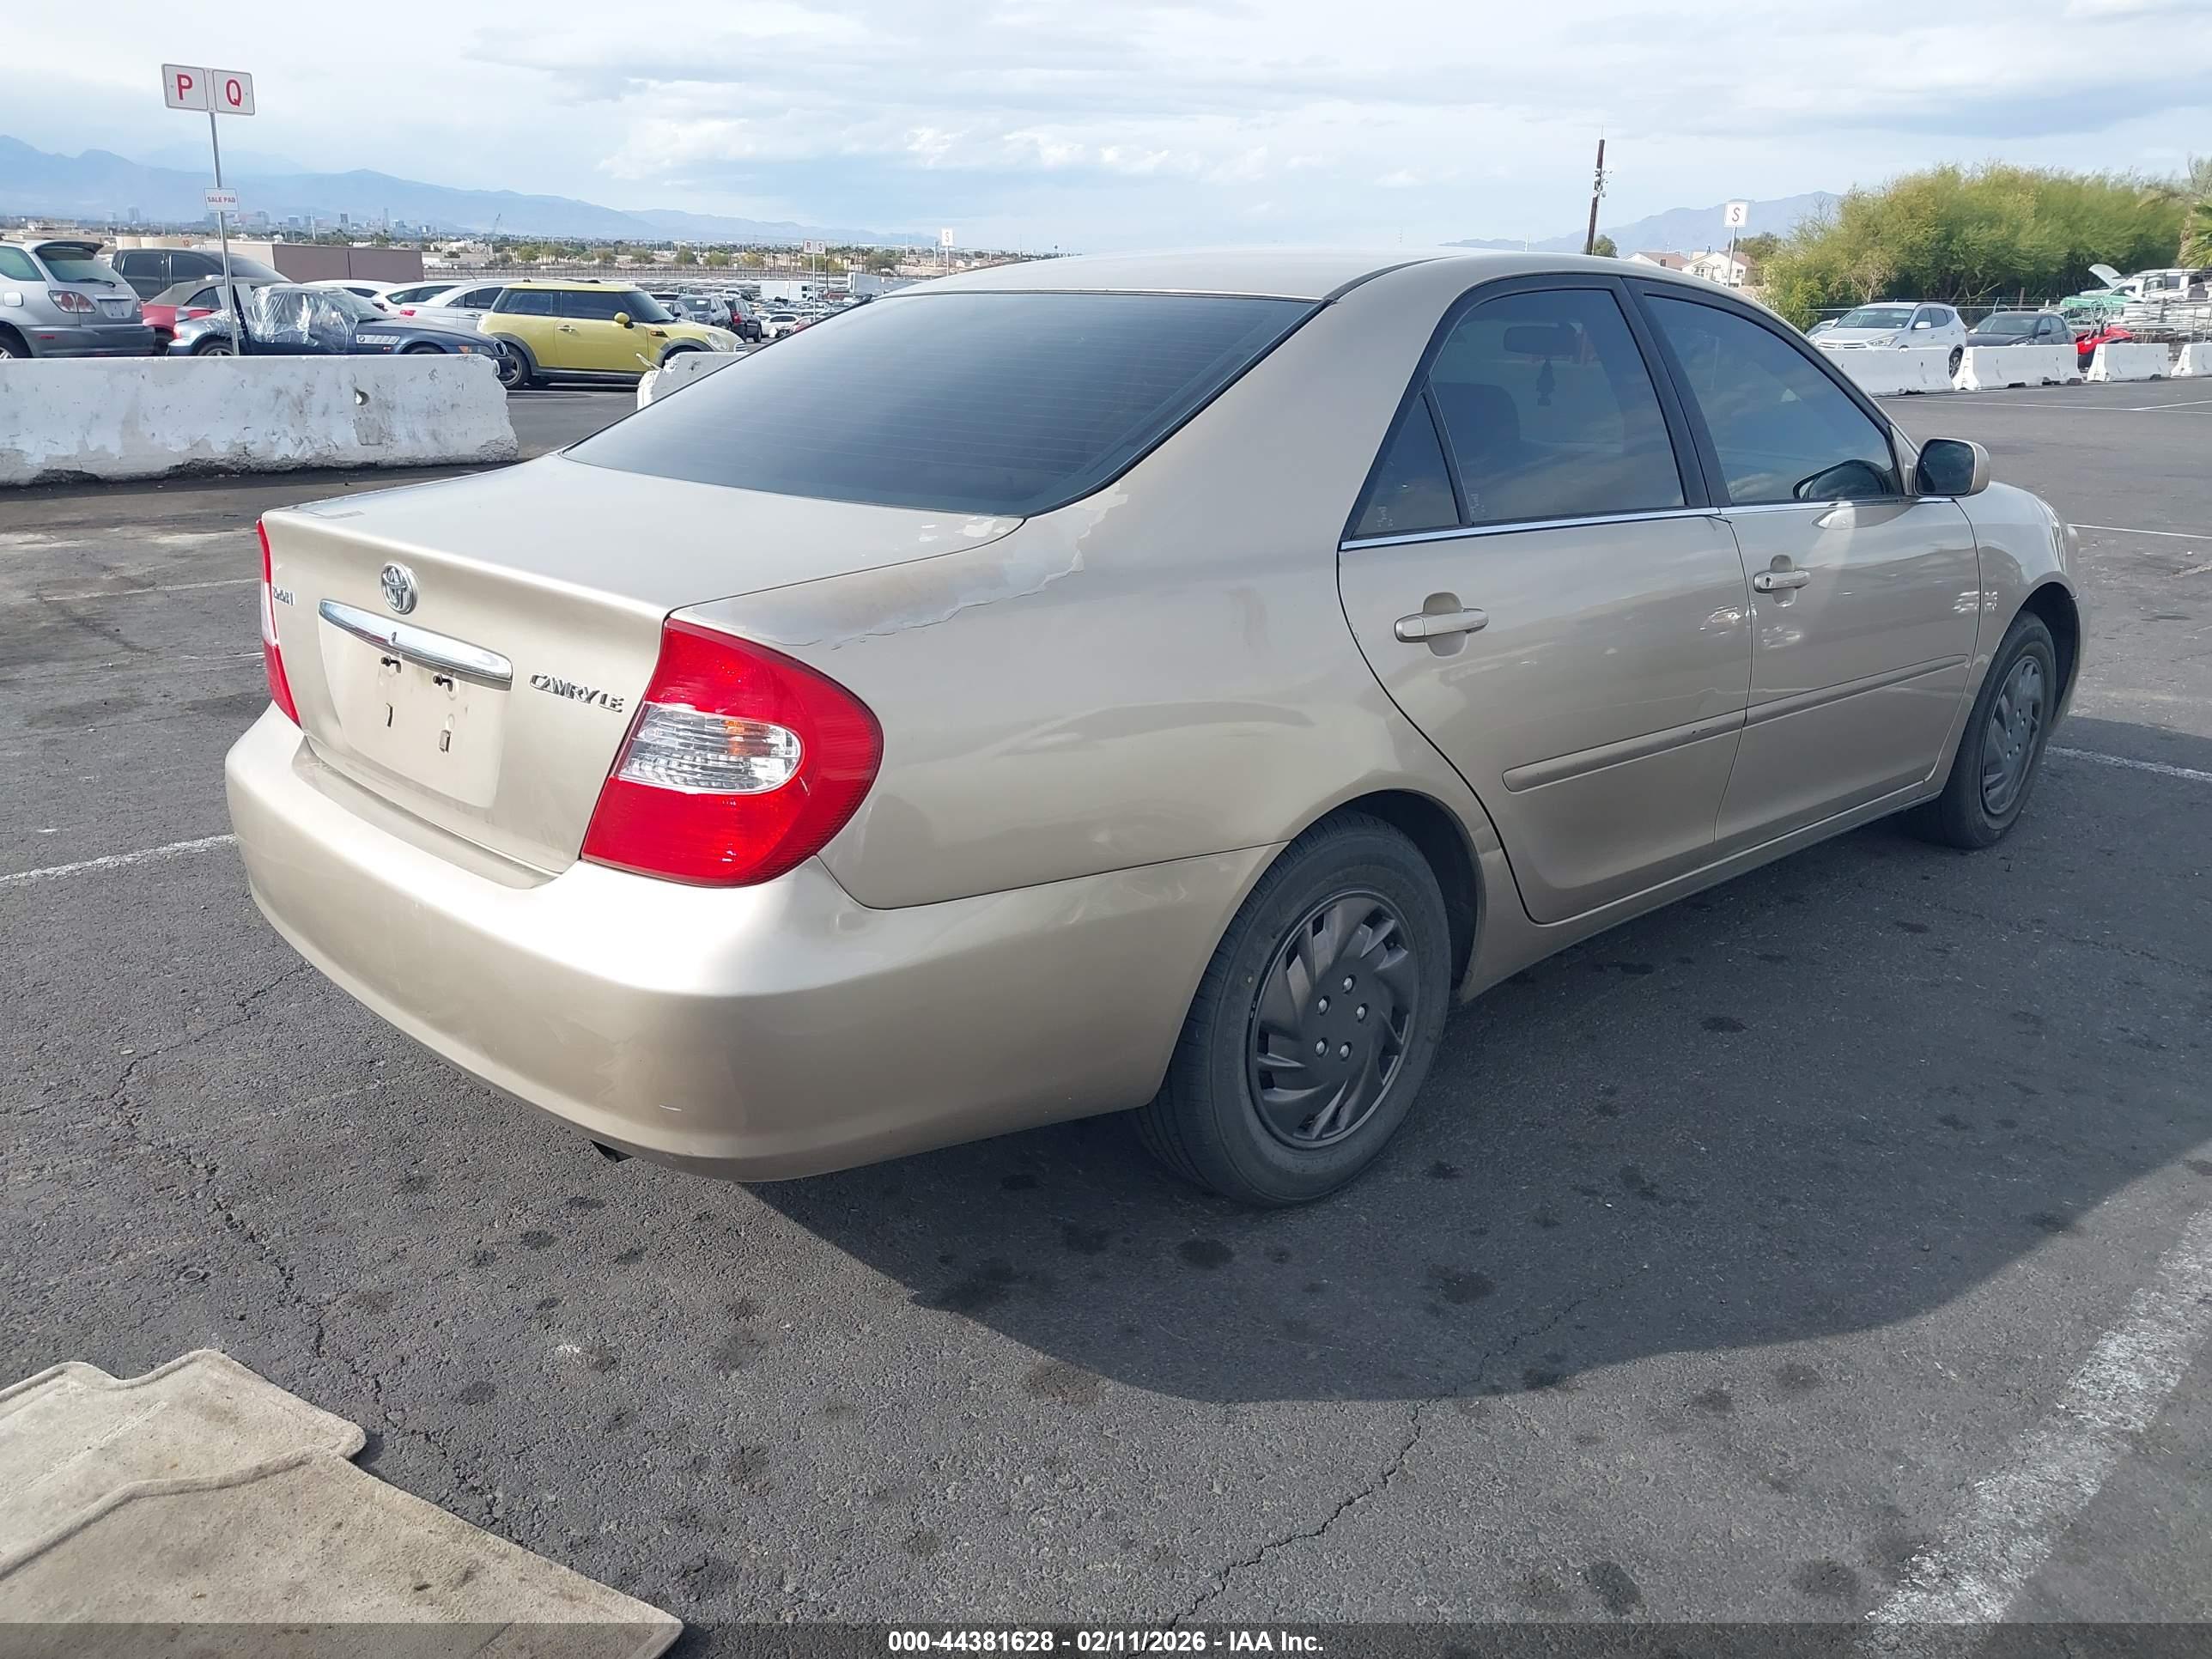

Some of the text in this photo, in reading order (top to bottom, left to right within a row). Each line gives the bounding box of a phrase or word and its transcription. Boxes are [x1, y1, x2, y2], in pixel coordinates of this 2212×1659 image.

[177, 74, 242, 106] P Q
[1732, 207, 1741, 222] S
[806, 241, 823, 252] R S
[530, 674, 624, 713] CAMRY LE
